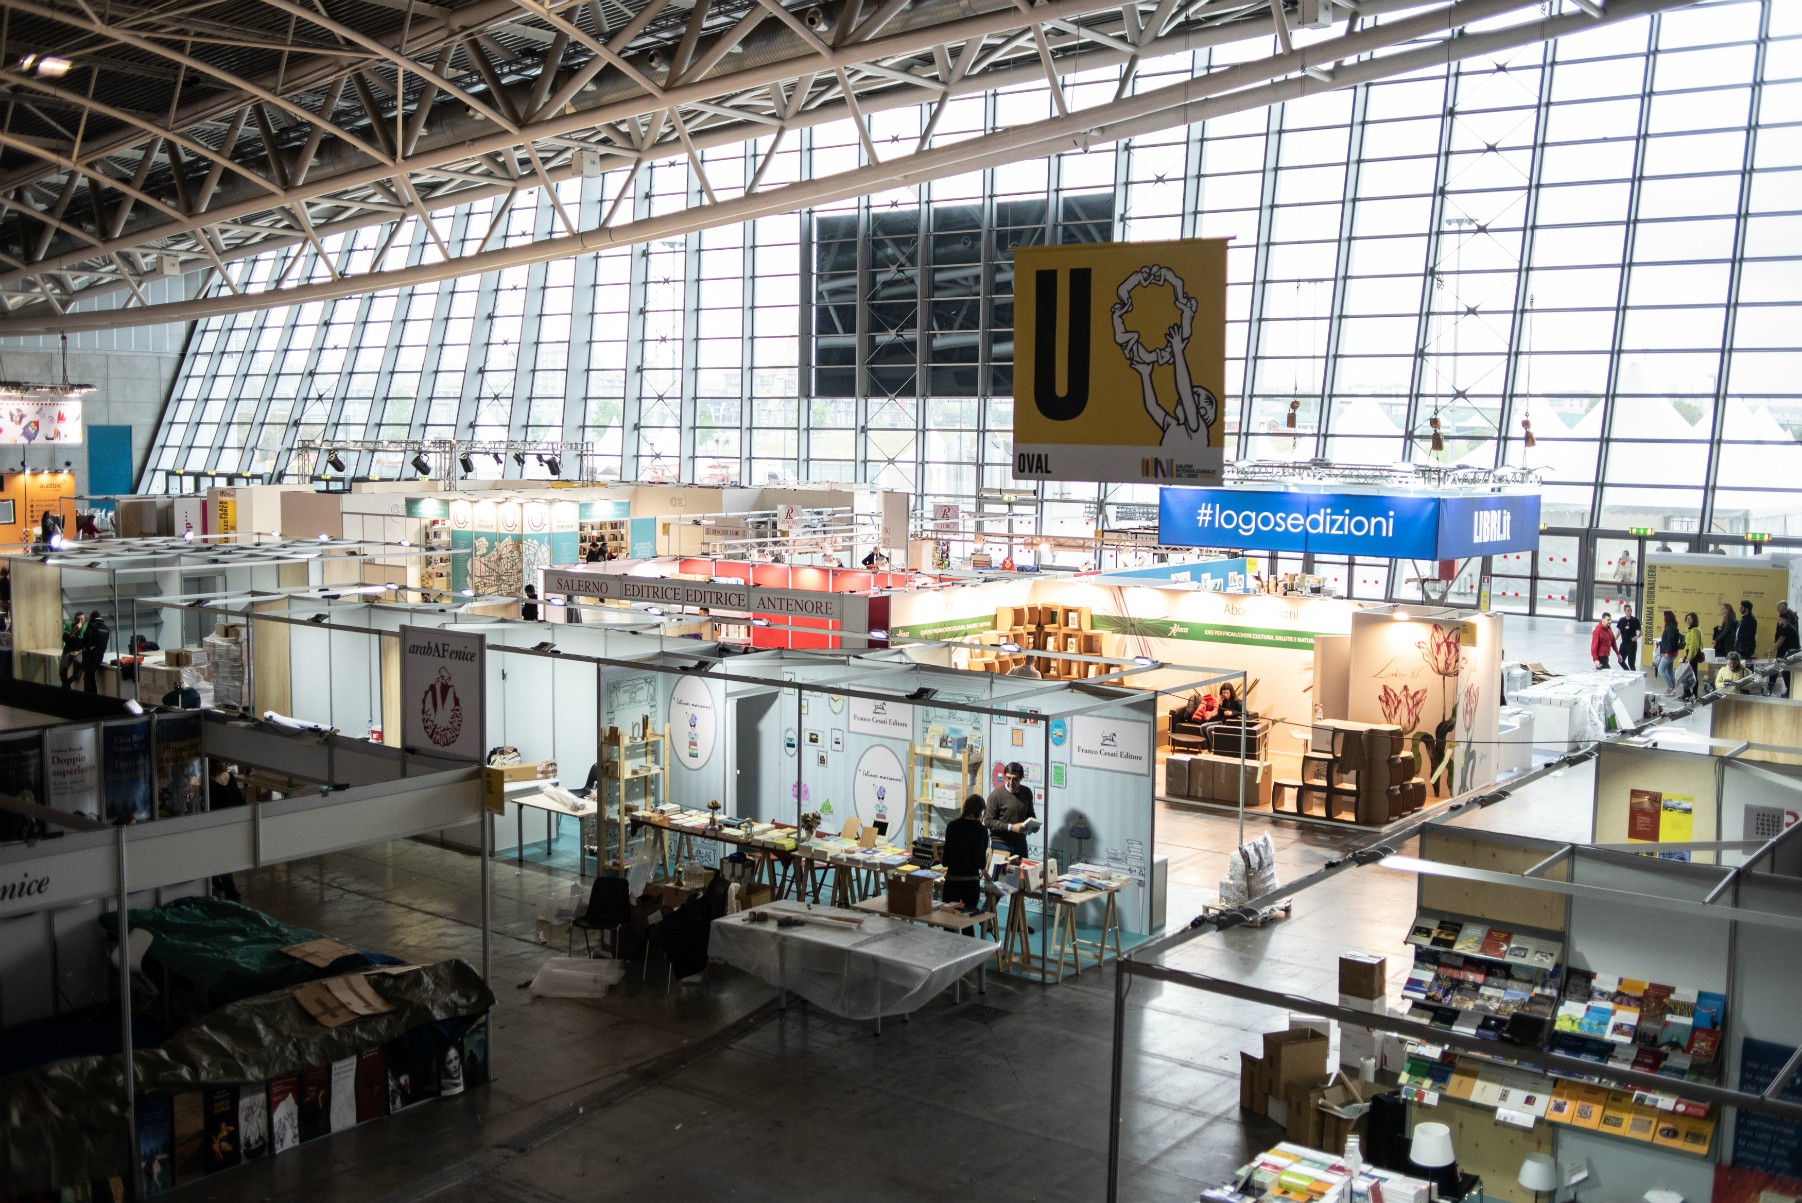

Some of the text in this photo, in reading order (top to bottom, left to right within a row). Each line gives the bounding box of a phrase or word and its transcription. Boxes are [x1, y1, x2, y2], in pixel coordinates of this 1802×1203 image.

[1034, 268, 1092, 422] U
[1018, 453, 1052, 474] OVAL
[1196, 502, 1394, 538] #logosedizioni
[556, 577, 833, 616] SALERNO EDITRICE EDITRICE ANTENORE
[1644, 564, 1657, 646] PROGRAMMA GIORNALIERO
[408, 642, 476, 662] arabAFenice
[854, 714, 908, 728] Franco Cesati Editore
[52, 754, 85, 768] Doppio
[1077, 746, 1142, 761] Franco Cesati Editore
